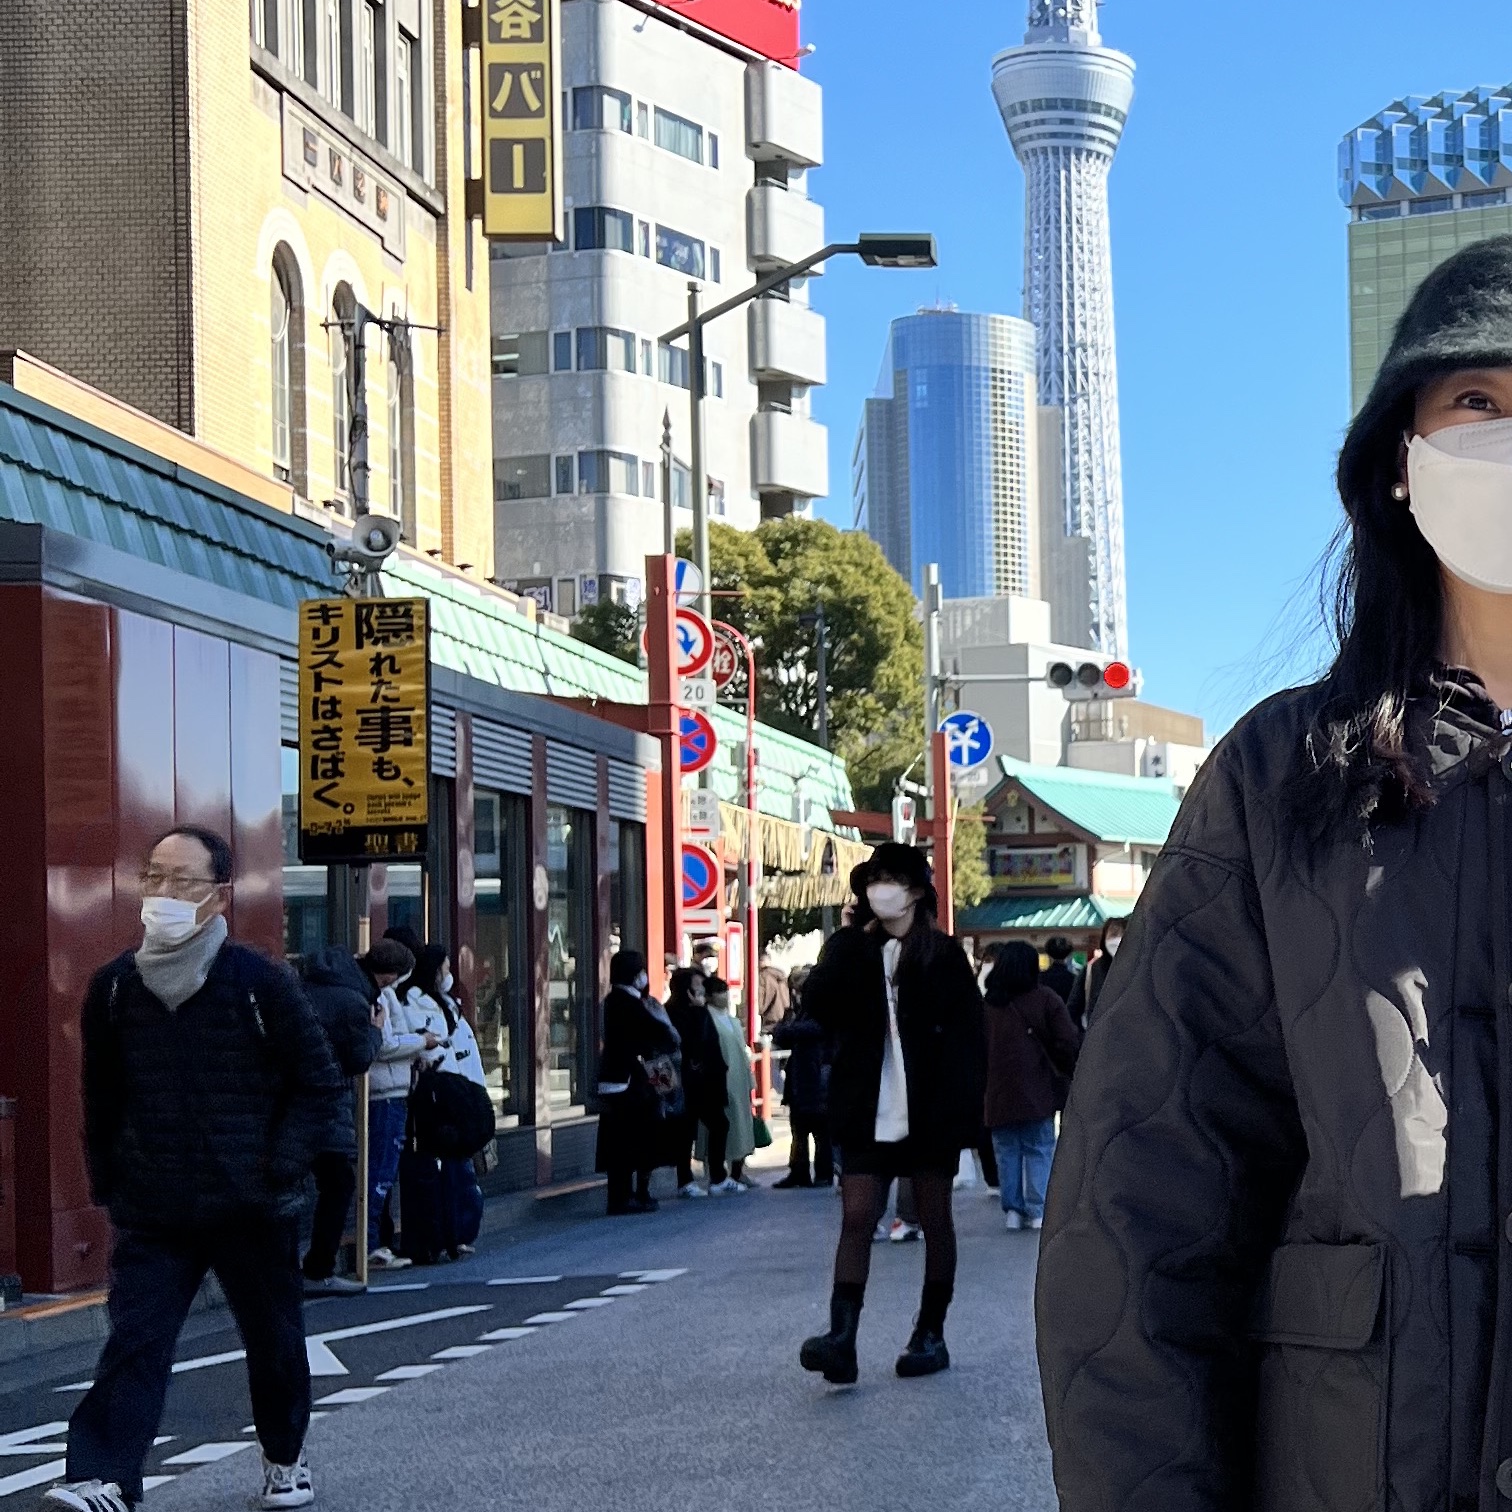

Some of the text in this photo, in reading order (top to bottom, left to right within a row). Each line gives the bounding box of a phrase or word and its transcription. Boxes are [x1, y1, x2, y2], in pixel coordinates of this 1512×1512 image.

[307, 604, 355, 815] キリストはさばく。
[355, 602, 416, 787] 隠れた事も、
